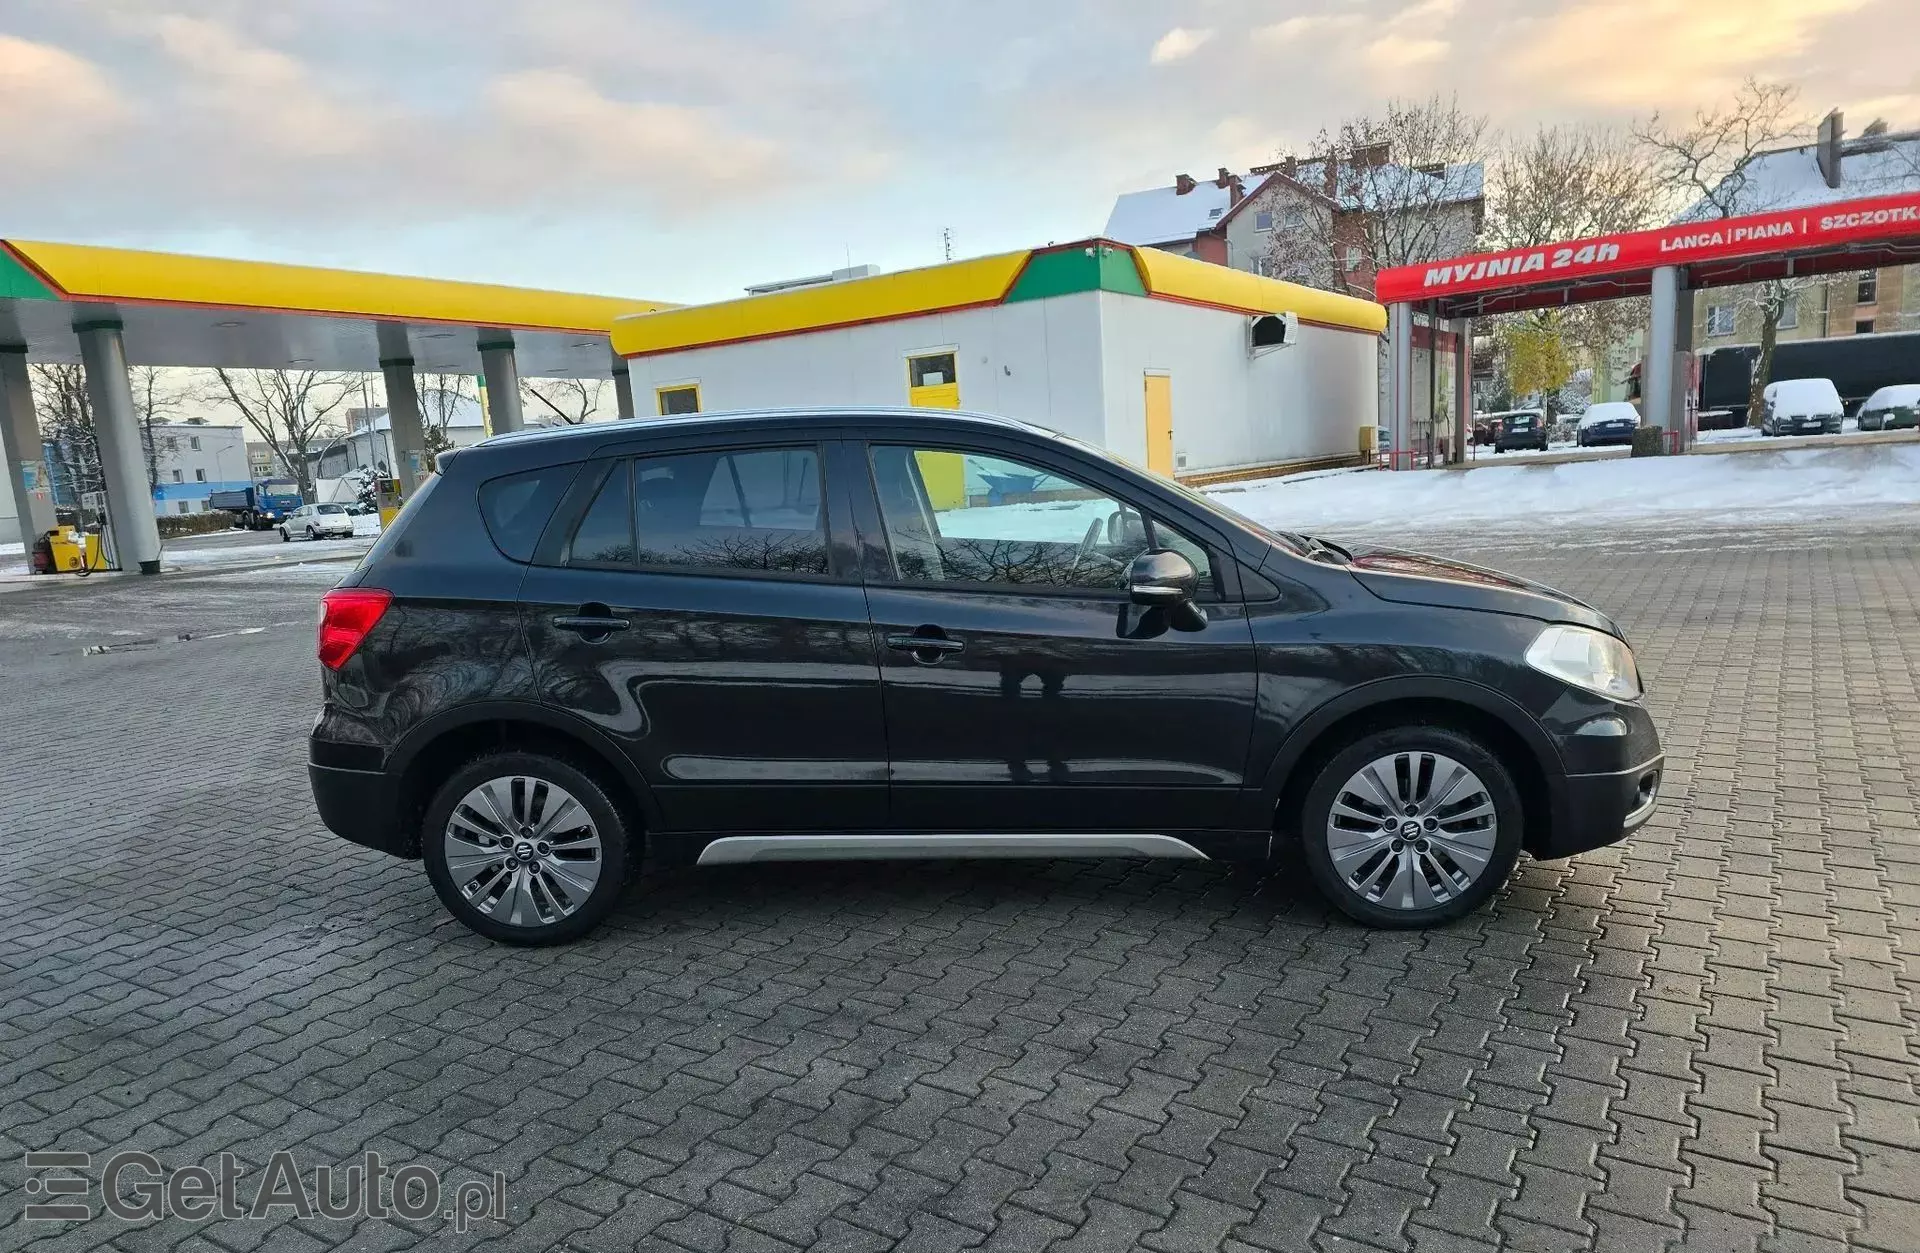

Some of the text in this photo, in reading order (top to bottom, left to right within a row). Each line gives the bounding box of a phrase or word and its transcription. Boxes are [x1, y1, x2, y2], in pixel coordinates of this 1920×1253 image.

[1660, 205, 1920, 252] LANCA PIANA SZCZOTK
[1424, 243, 1620, 287] MYJNIA 24h
